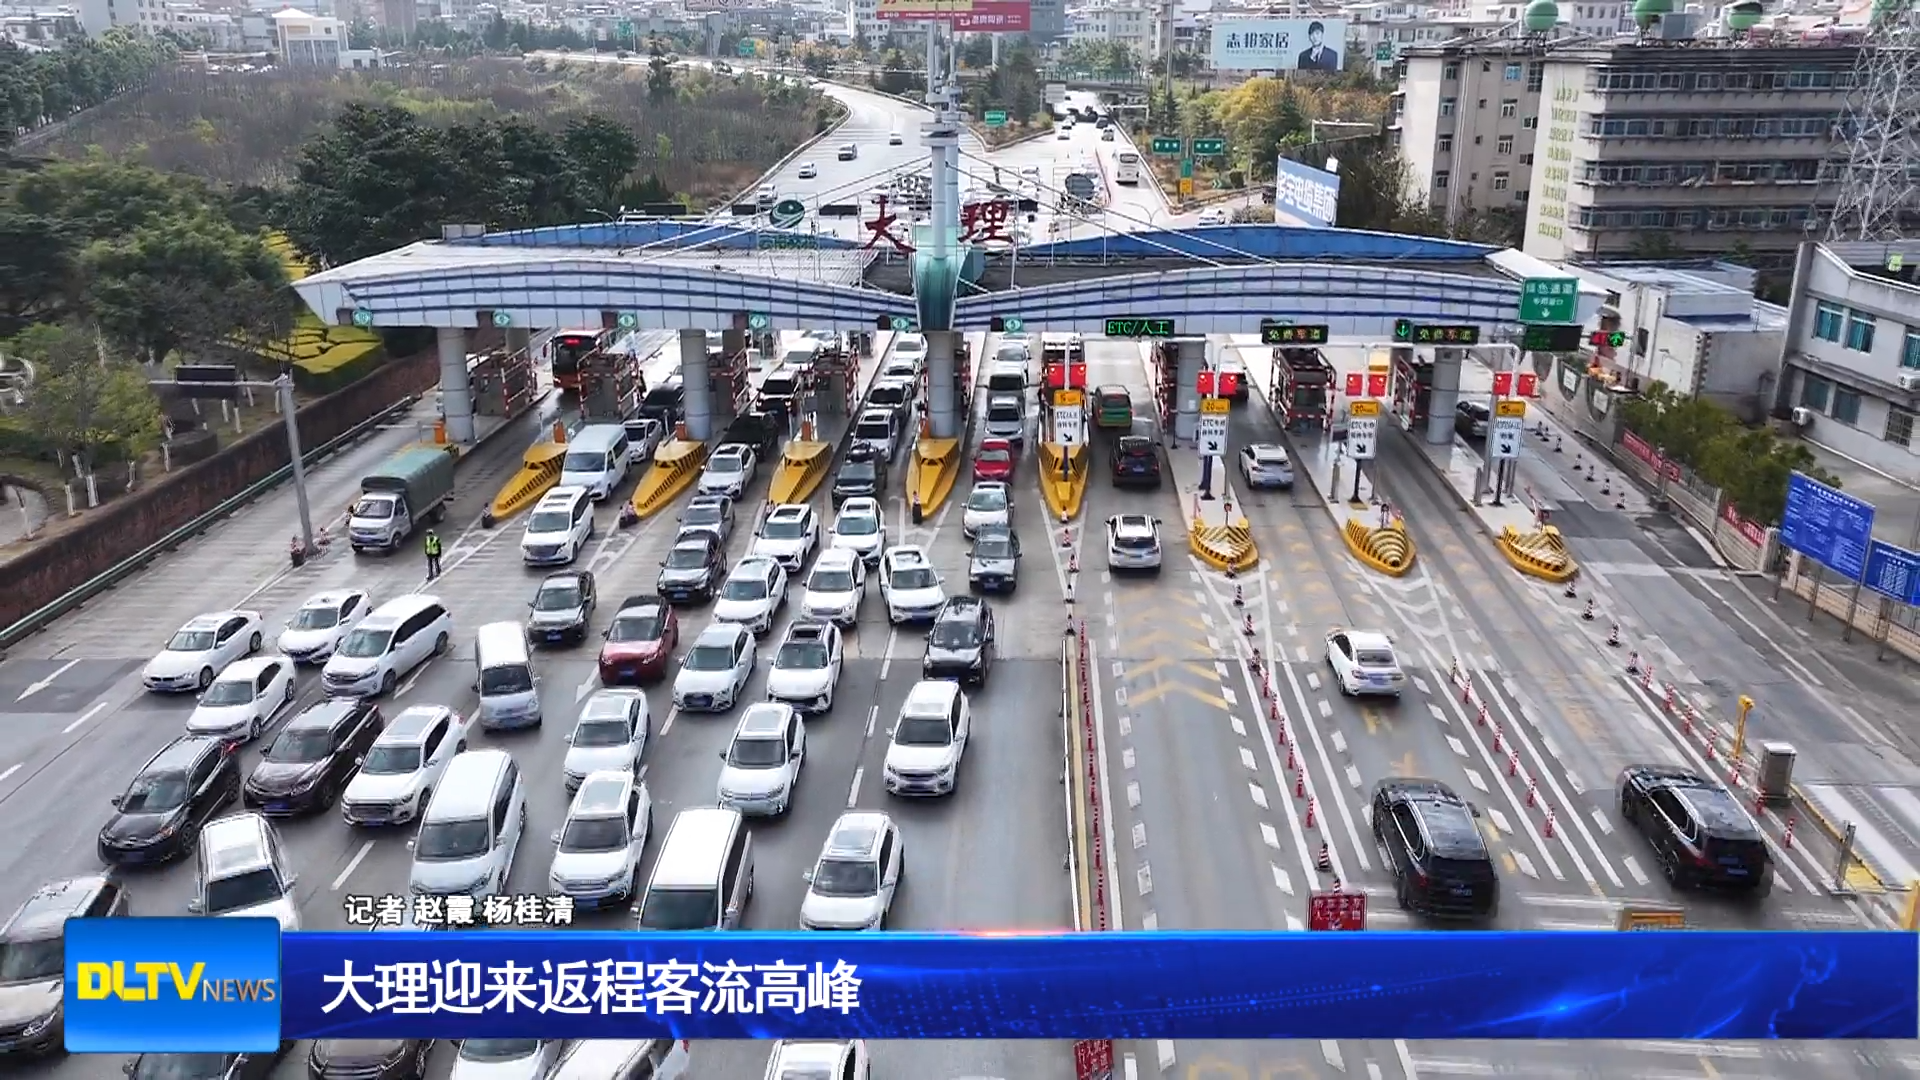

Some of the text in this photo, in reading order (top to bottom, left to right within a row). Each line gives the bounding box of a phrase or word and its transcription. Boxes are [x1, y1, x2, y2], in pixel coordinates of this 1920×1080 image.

[1107, 321, 1169, 335] ETC/人工
[1268, 330, 1322, 340] 免费车道
